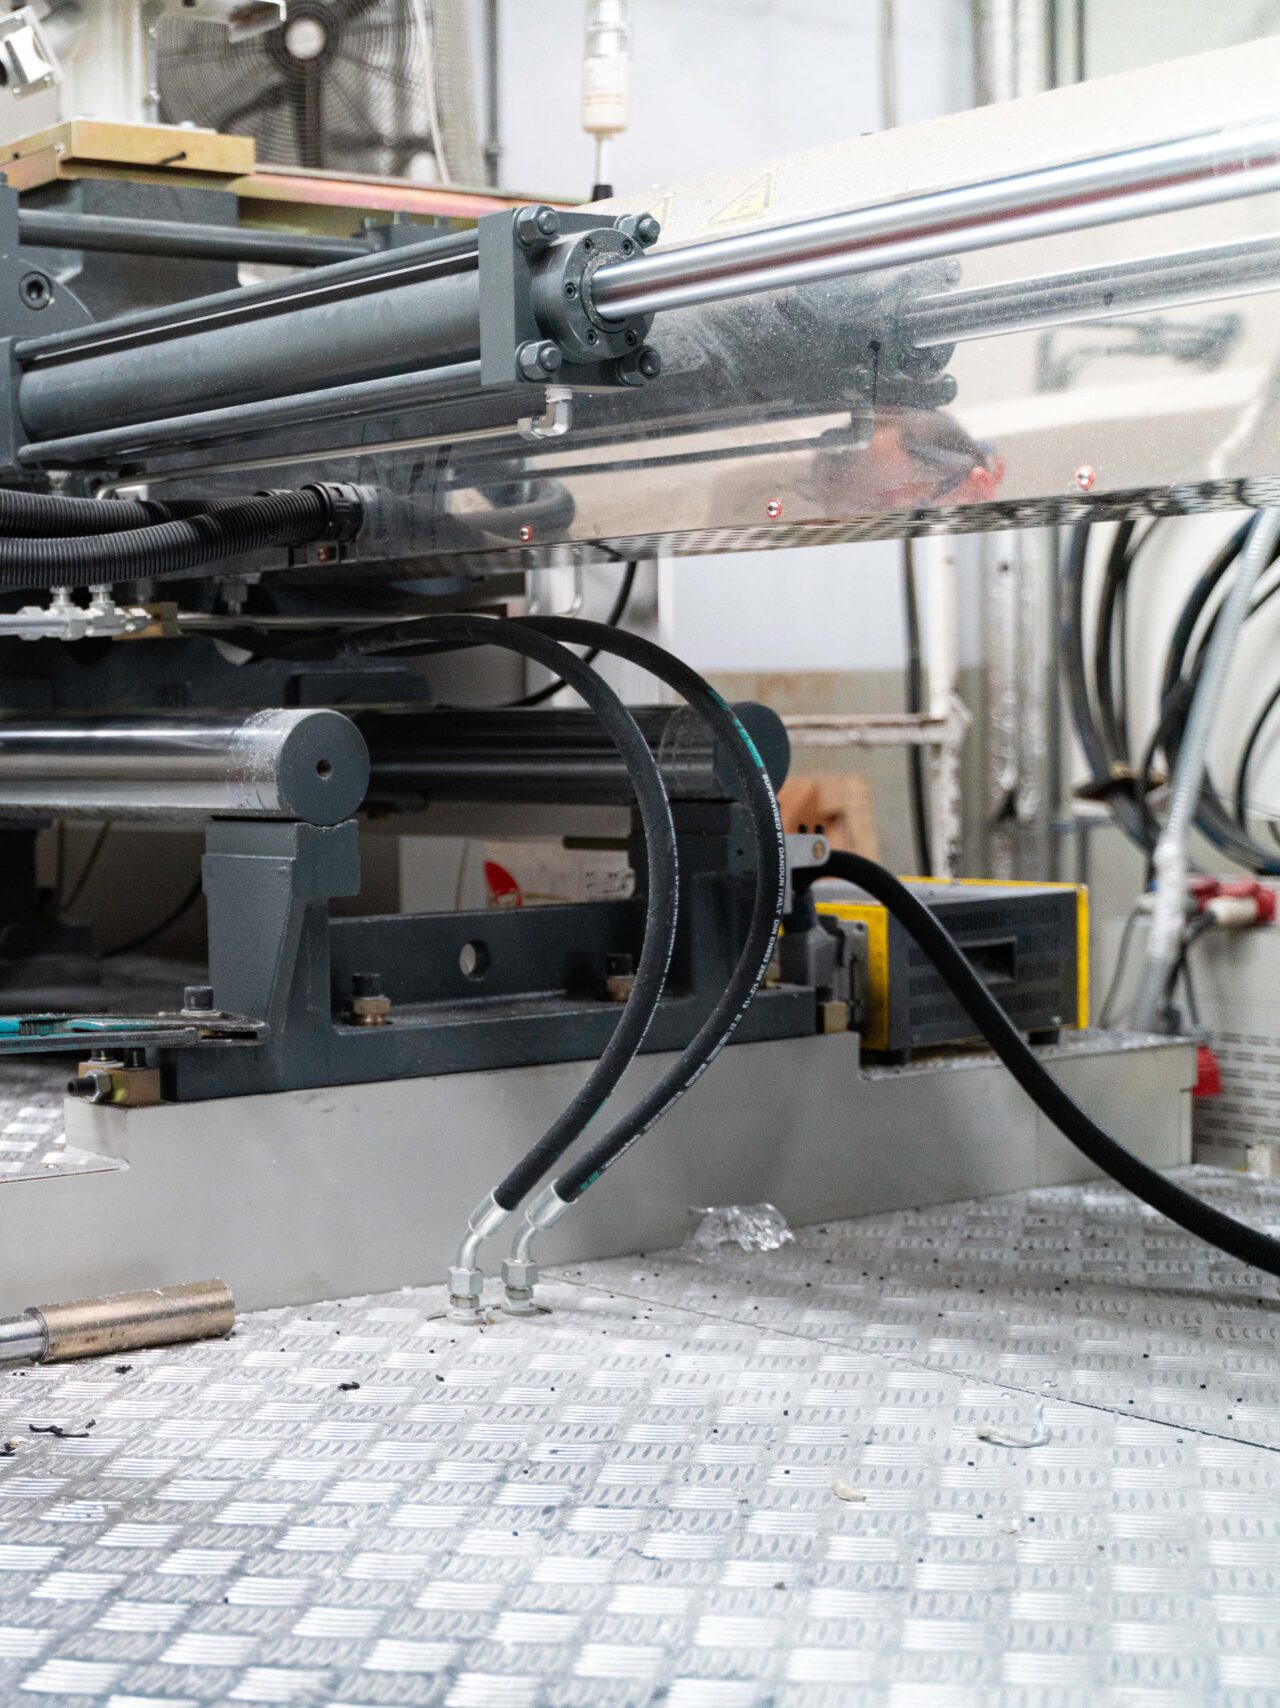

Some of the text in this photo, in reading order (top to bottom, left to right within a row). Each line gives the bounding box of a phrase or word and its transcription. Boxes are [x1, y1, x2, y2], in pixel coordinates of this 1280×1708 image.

[776, 832, 784, 845] BY
[775, 889, 785, 915] ITALY
[771, 919, 780, 935] DIN
